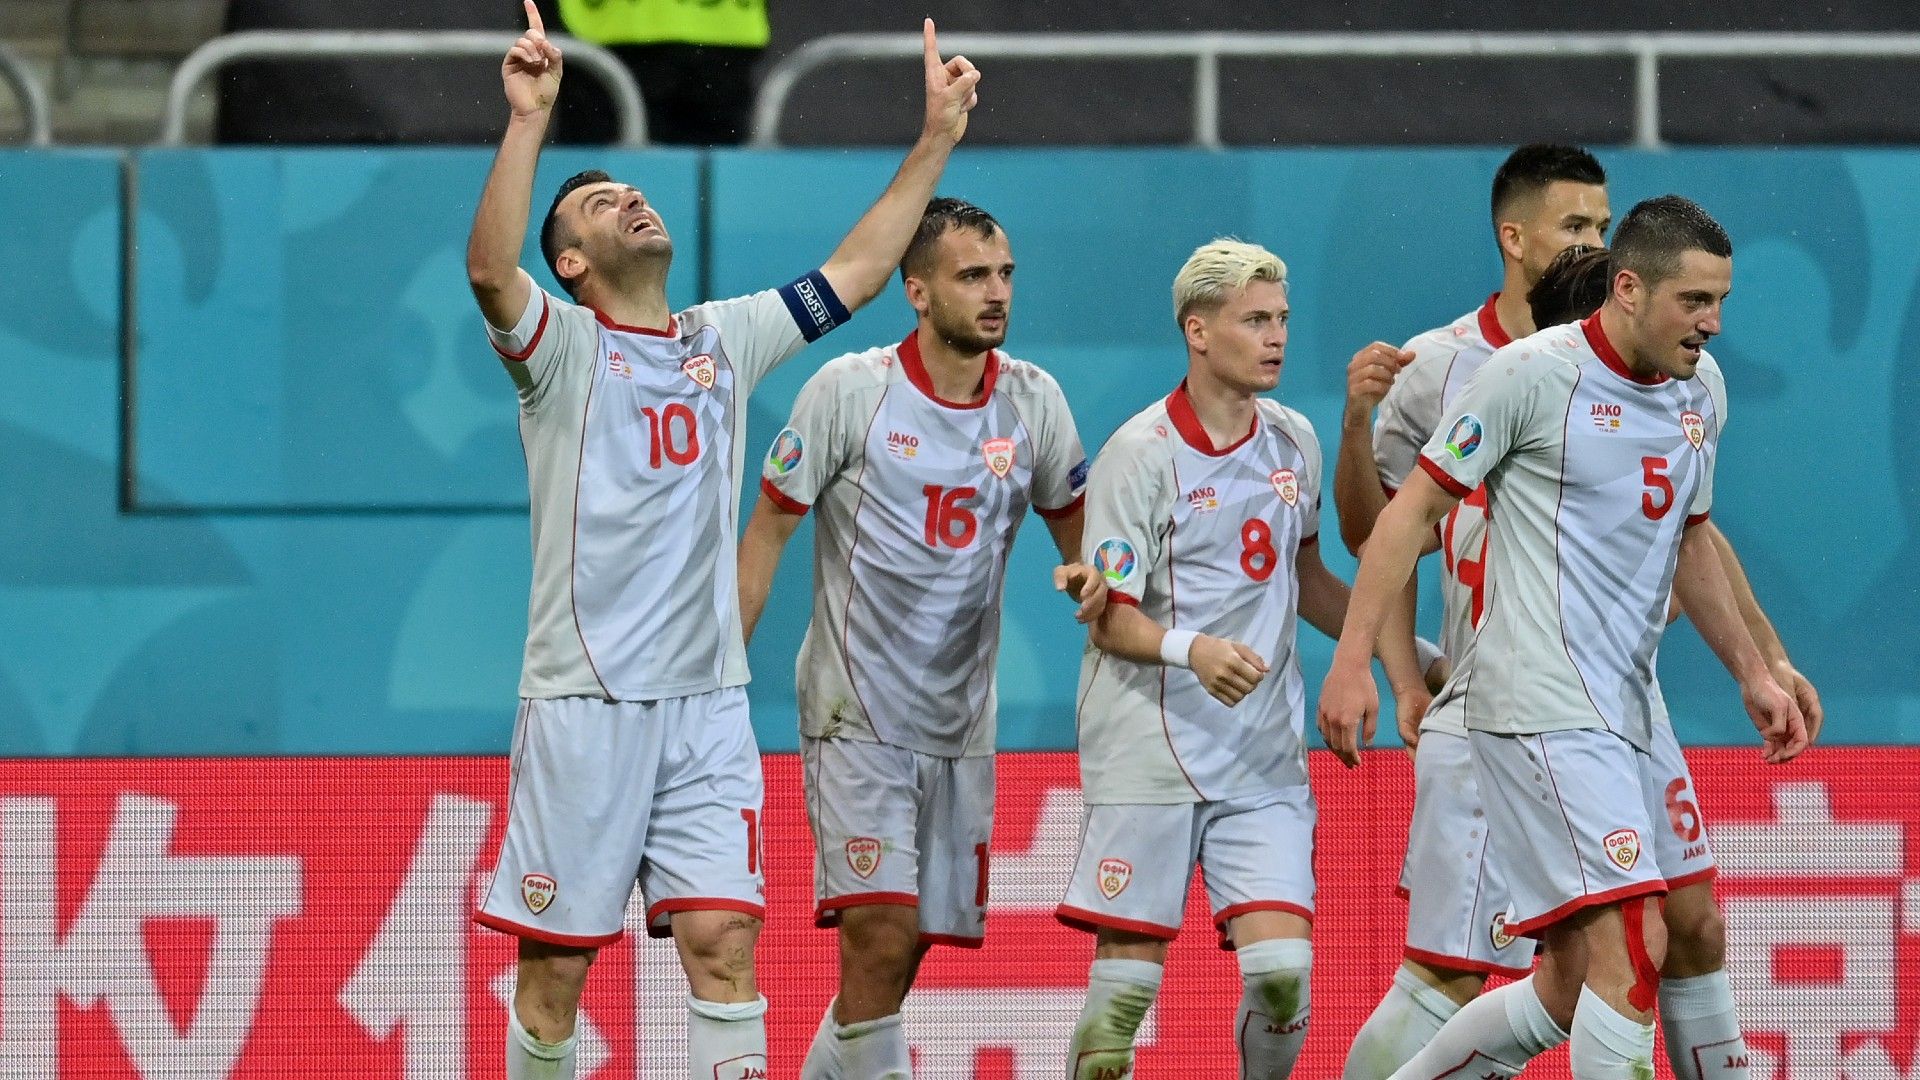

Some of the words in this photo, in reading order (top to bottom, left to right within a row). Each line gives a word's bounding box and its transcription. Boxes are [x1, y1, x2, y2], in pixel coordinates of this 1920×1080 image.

[797, 280, 828, 324] RESPECT
[608, 350, 626, 362] JA
[640, 403, 700, 469] 10
[886, 430, 919, 448] JAKO
[1590, 403, 1621, 417] JAKO
[922, 484, 977, 548] 16
[1187, 486, 1216, 502] JAKO
[1641, 456, 1674, 521] 5
[1240, 517, 1277, 582] 8
[740, 807, 763, 874] 1
[1664, 776, 1700, 842] 6
[975, 842, 989, 907] 1
[739, 1067, 766, 1080] JAK
